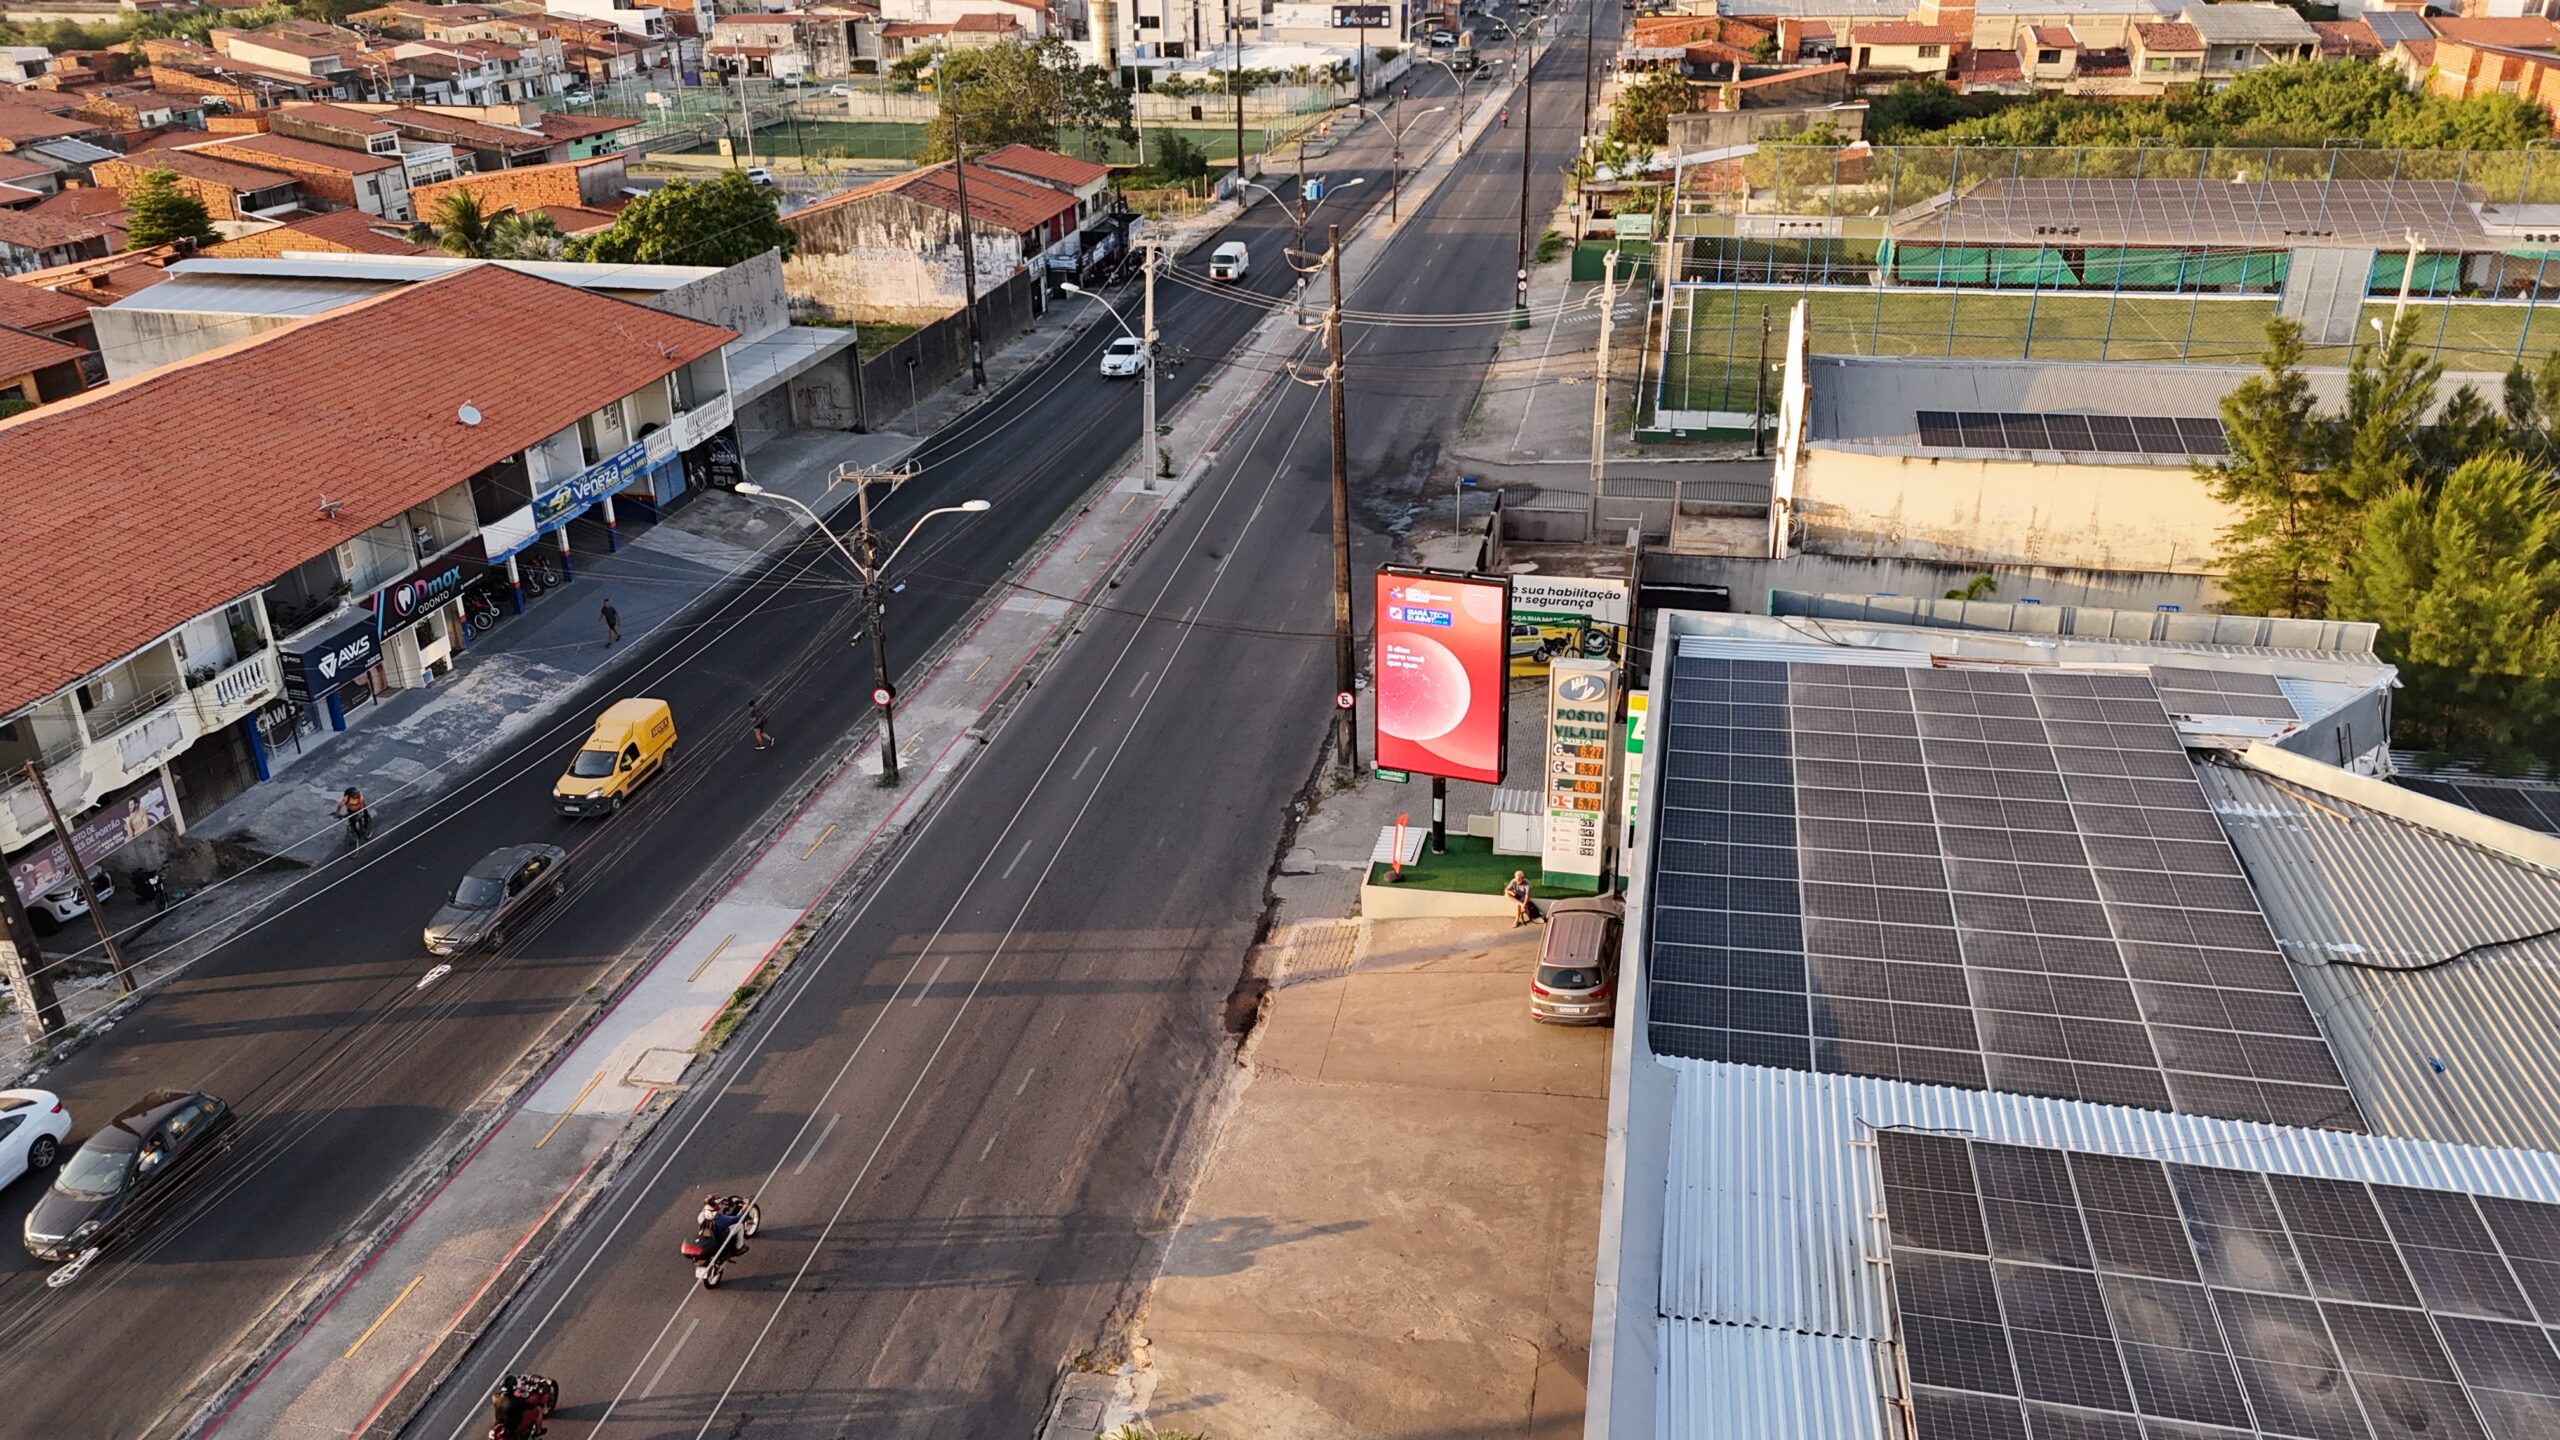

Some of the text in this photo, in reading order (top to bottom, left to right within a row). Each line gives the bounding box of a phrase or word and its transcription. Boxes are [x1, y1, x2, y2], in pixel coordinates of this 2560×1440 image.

[573, 465, 620, 499] Veneza
[415, 565, 461, 599] Dmax
[1521, 587, 1544, 595] sua
[1547, 586, 1621, 600] habilitação
[418, 590, 450, 614] ODONTO
[1525, 597, 1594, 609] segurança
[1429, 611, 1449, 619] TECH
[338, 634, 370, 667] AWS
[1557, 709, 1605, 722] POSTO
[1554, 725, 1587, 738] VILA
[1553, 744, 1563, 756] G
[1580, 747, 1602, 759] 6.27
[1553, 761, 1600, 776] G 6.37
[1575, 780, 1597, 793] 4.99
[1577, 798, 1599, 810] 5.79
[95, 819, 121, 839] PORTÃO
